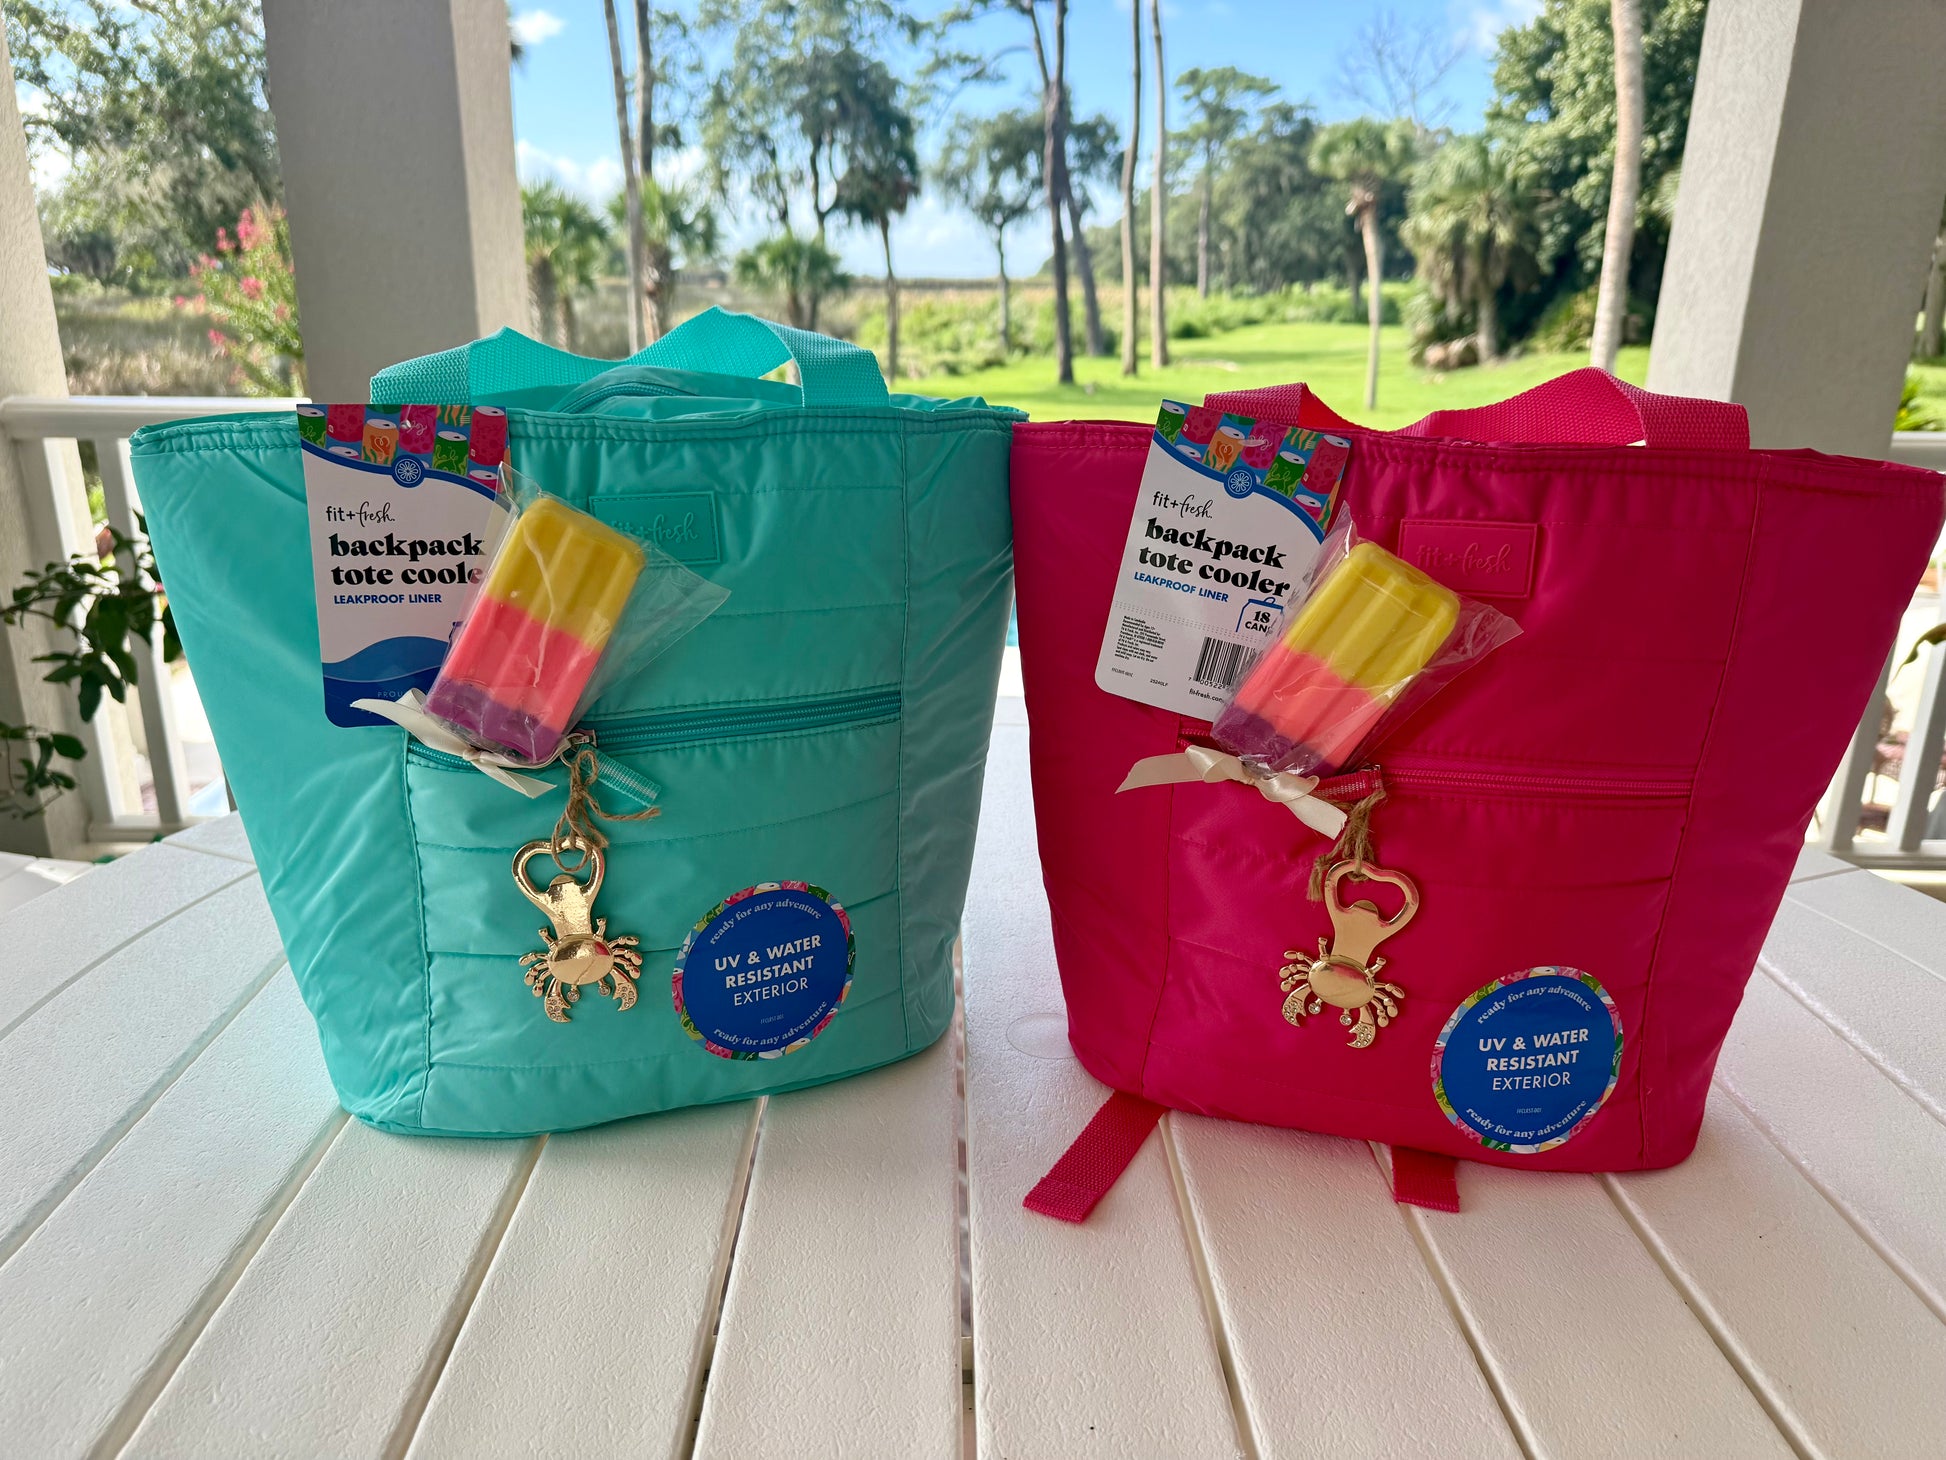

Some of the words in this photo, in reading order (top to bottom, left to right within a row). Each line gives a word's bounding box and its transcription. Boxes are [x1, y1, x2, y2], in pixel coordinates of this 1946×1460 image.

[329, 532, 487, 562] backpack
[1145, 517, 1287, 569] backpack
[1416, 542, 1511, 576] fit+fresh
[331, 566, 394, 586] tote
[401, 561, 484, 586] coole
[1133, 571, 1197, 595] LEAKPROOF
[1198, 587, 1229, 603] LINER
[1138, 546, 1193, 574] tote
[1198, 564, 1291, 598] cooler
[334, 594, 405, 605] LEAKPROOF
[409, 593, 443, 604] LINER
[1252, 610, 1271, 624] 18
[377, 690, 404, 699] PROU
[709, 918, 735, 945] ready
[736, 908, 752, 921] for
[754, 901, 774, 912] any
[776, 898, 823, 920] adventure
[714, 953, 741, 971] UV
[747, 951, 760, 965] &
[766, 934, 822, 960] WATER
[725, 956, 814, 989] RESISTANT
[734, 977, 809, 1006] EXTERIOR
[1477, 999, 1506, 1024] ready
[1507, 991, 1525, 1002] for
[1526, 987, 1547, 997] any
[1547, 986, 1592, 1012] adventure
[713, 1027, 742, 1045] ready
[742, 1036, 759, 1046] for
[760, 1035, 780, 1046] any
[782, 1000, 828, 1041] adventure
[1478, 1037, 1507, 1051] UV
[1512, 1036, 1526, 1050] &
[1533, 1028, 1589, 1049] WATER
[1486, 1050, 1580, 1071] RESISTANT
[1492, 1072, 1571, 1091] EXTERIOR
[1466, 1107, 1495, 1131] ready
[1495, 1126, 1513, 1137] for
[1513, 1129, 1535, 1139] any
[1537, 1100, 1587, 1135] adventure
